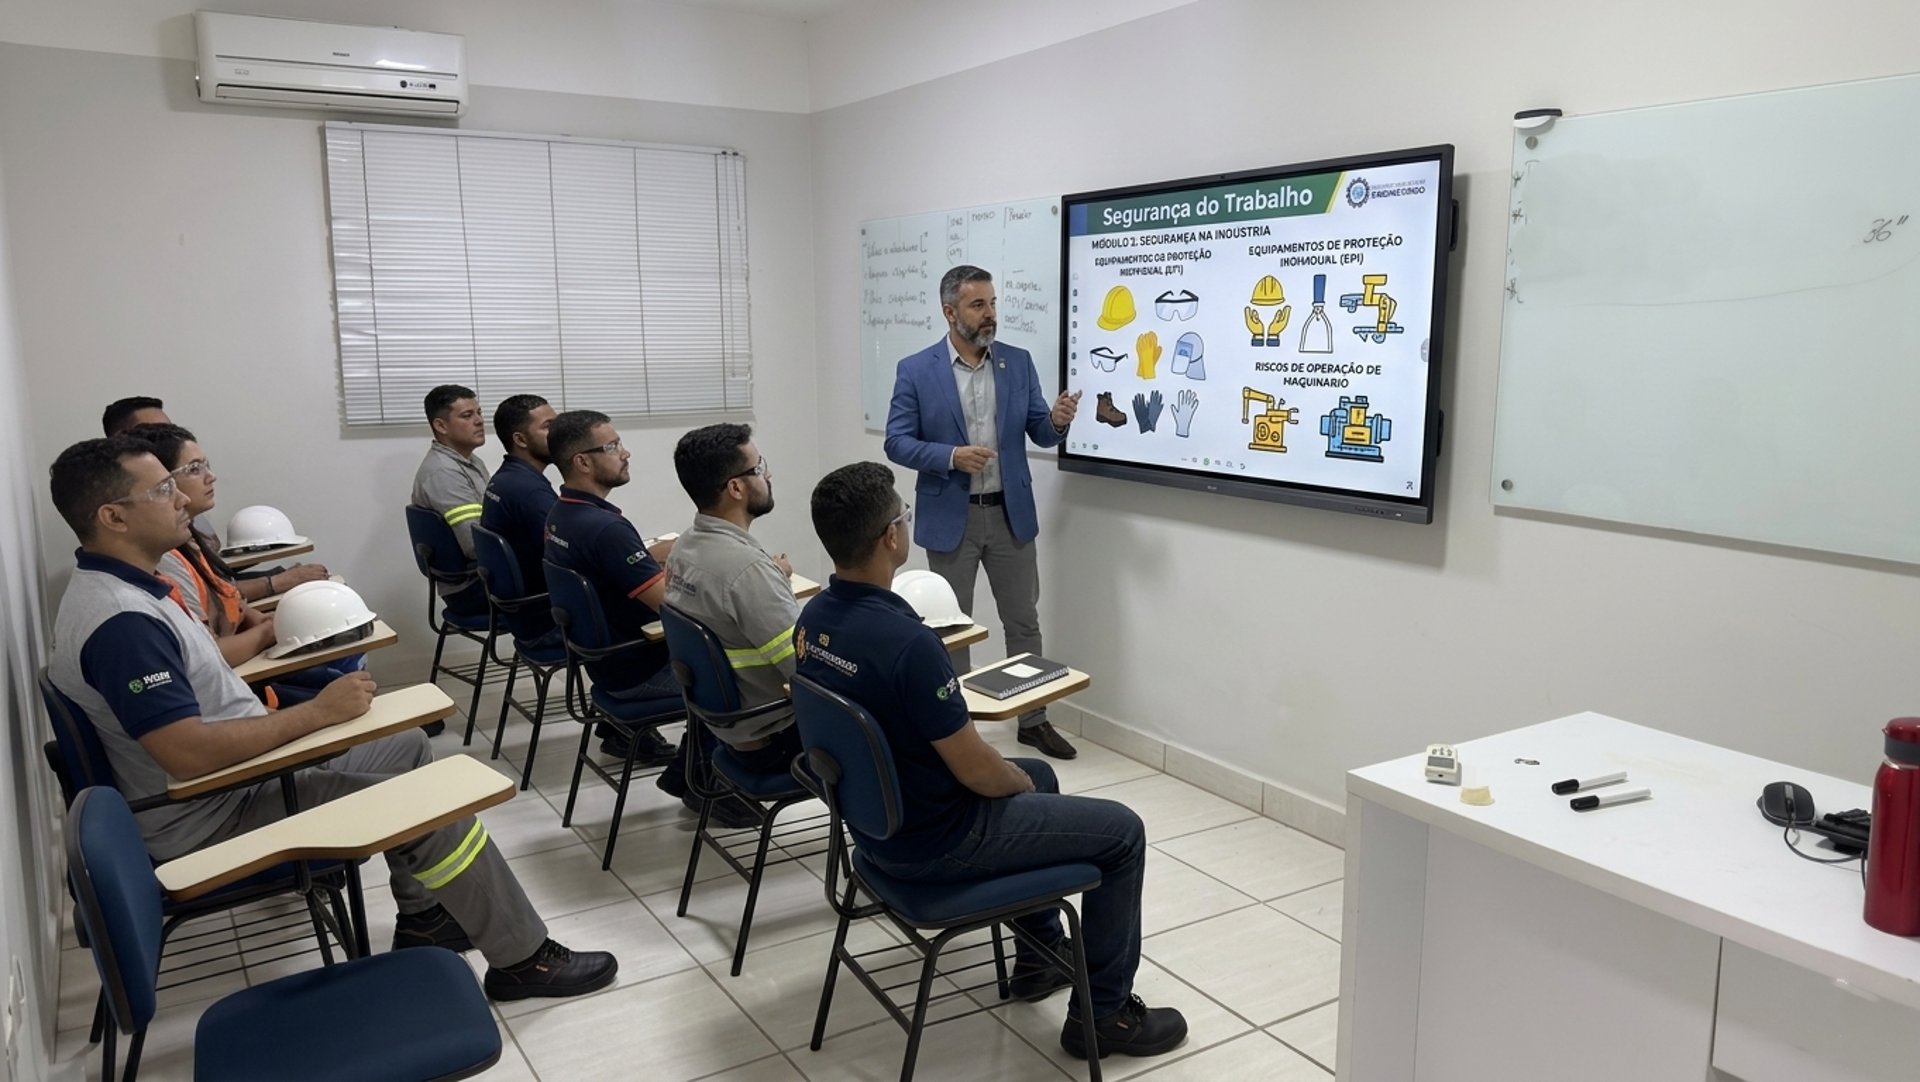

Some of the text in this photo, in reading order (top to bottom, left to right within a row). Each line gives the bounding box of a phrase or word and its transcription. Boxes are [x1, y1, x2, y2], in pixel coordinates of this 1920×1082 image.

[1103, 186, 1313, 228] Segurança do Trabalho
[1199, 230, 1213, 241] NA
[1249, 233, 1404, 257] EQUIPAMENTOS DE PROTEÇÃO
[1340, 252, 1364, 266] (EPI)
[1255, 362, 1382, 376] RISCOS DE OPERAÇÃO DE
